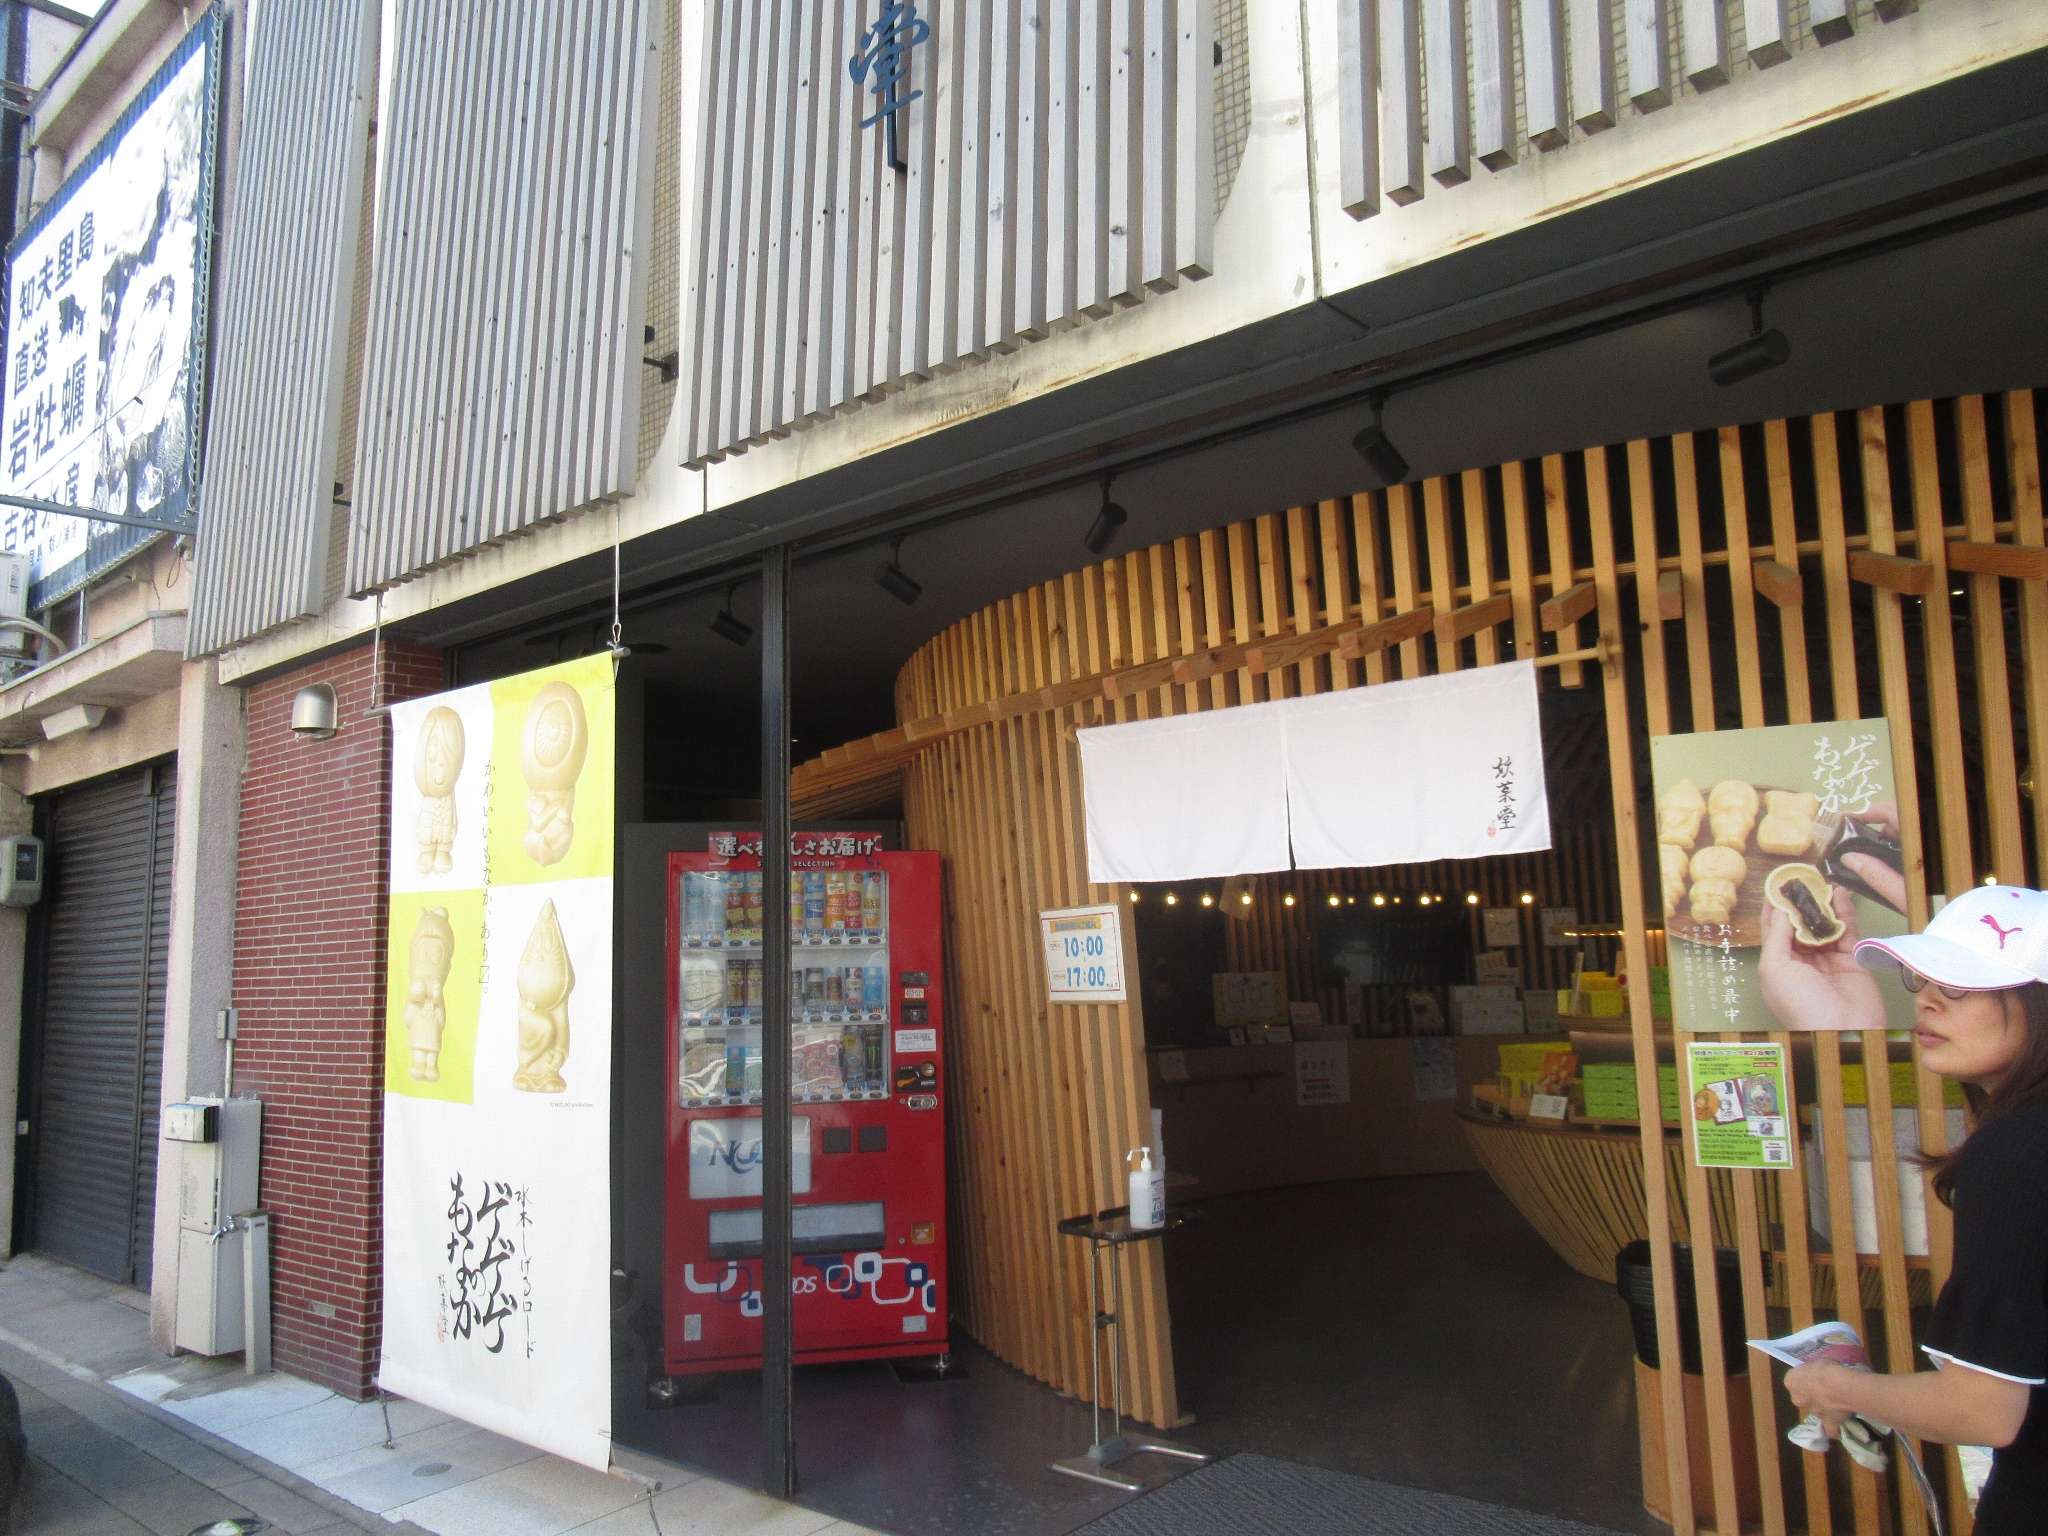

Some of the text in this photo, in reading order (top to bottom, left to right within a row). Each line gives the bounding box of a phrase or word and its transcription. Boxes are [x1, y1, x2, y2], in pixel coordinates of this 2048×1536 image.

[17, 210, 95, 332] 知夫里島
[8, 352, 88, 482] 岩牡蠣
[13, 322, 49, 400] 直送
[1064, 935, 1104, 957] 10:00
[1067, 965, 1106, 987] 17:00
[447, 1171, 487, 1340] もなか
[477, 1180, 518, 1354] ゲゲゲ
[515, 1183, 537, 1359] 水木しげるロード
